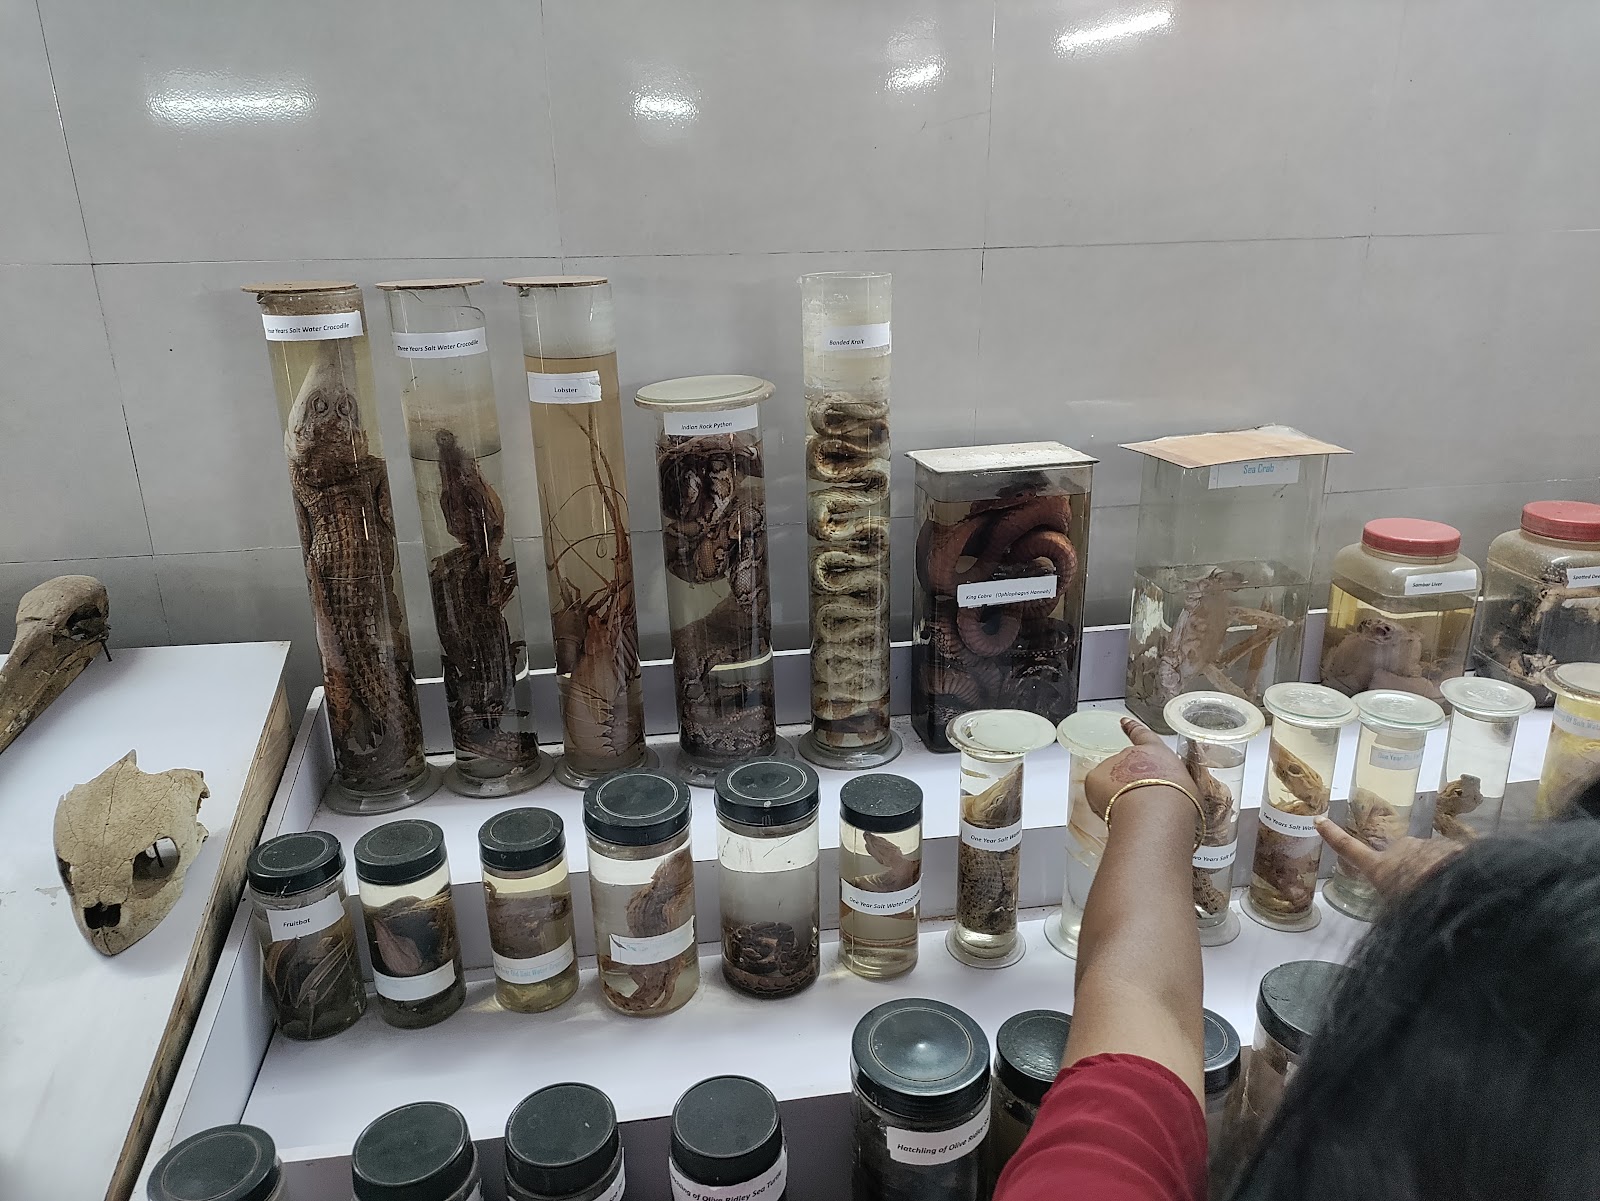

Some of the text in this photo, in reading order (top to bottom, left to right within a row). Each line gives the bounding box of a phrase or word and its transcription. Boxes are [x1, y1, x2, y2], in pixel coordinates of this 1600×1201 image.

[323, 322, 350, 331] Crocodile
[437, 342, 456, 351] Water
[456, 338, 479, 349] Crocodile
[714, 421, 732, 429] Python
[1243, 462, 1274, 474] Sea Crab
[1263, 812, 1272, 821] Two
[1272, 818, 1288, 828] Years
[970, 834, 982, 842] One
[850, 896, 859, 904] One
[283, 918, 310, 928] Fruitbat
[898, 1144, 937, 1154] Hatchling
[938, 1145, 948, 1154] of
[949, 1139, 967, 1152] Olive
[692, 1192, 700, 1201] of
[752, 1186, 766, 1198] Sea
